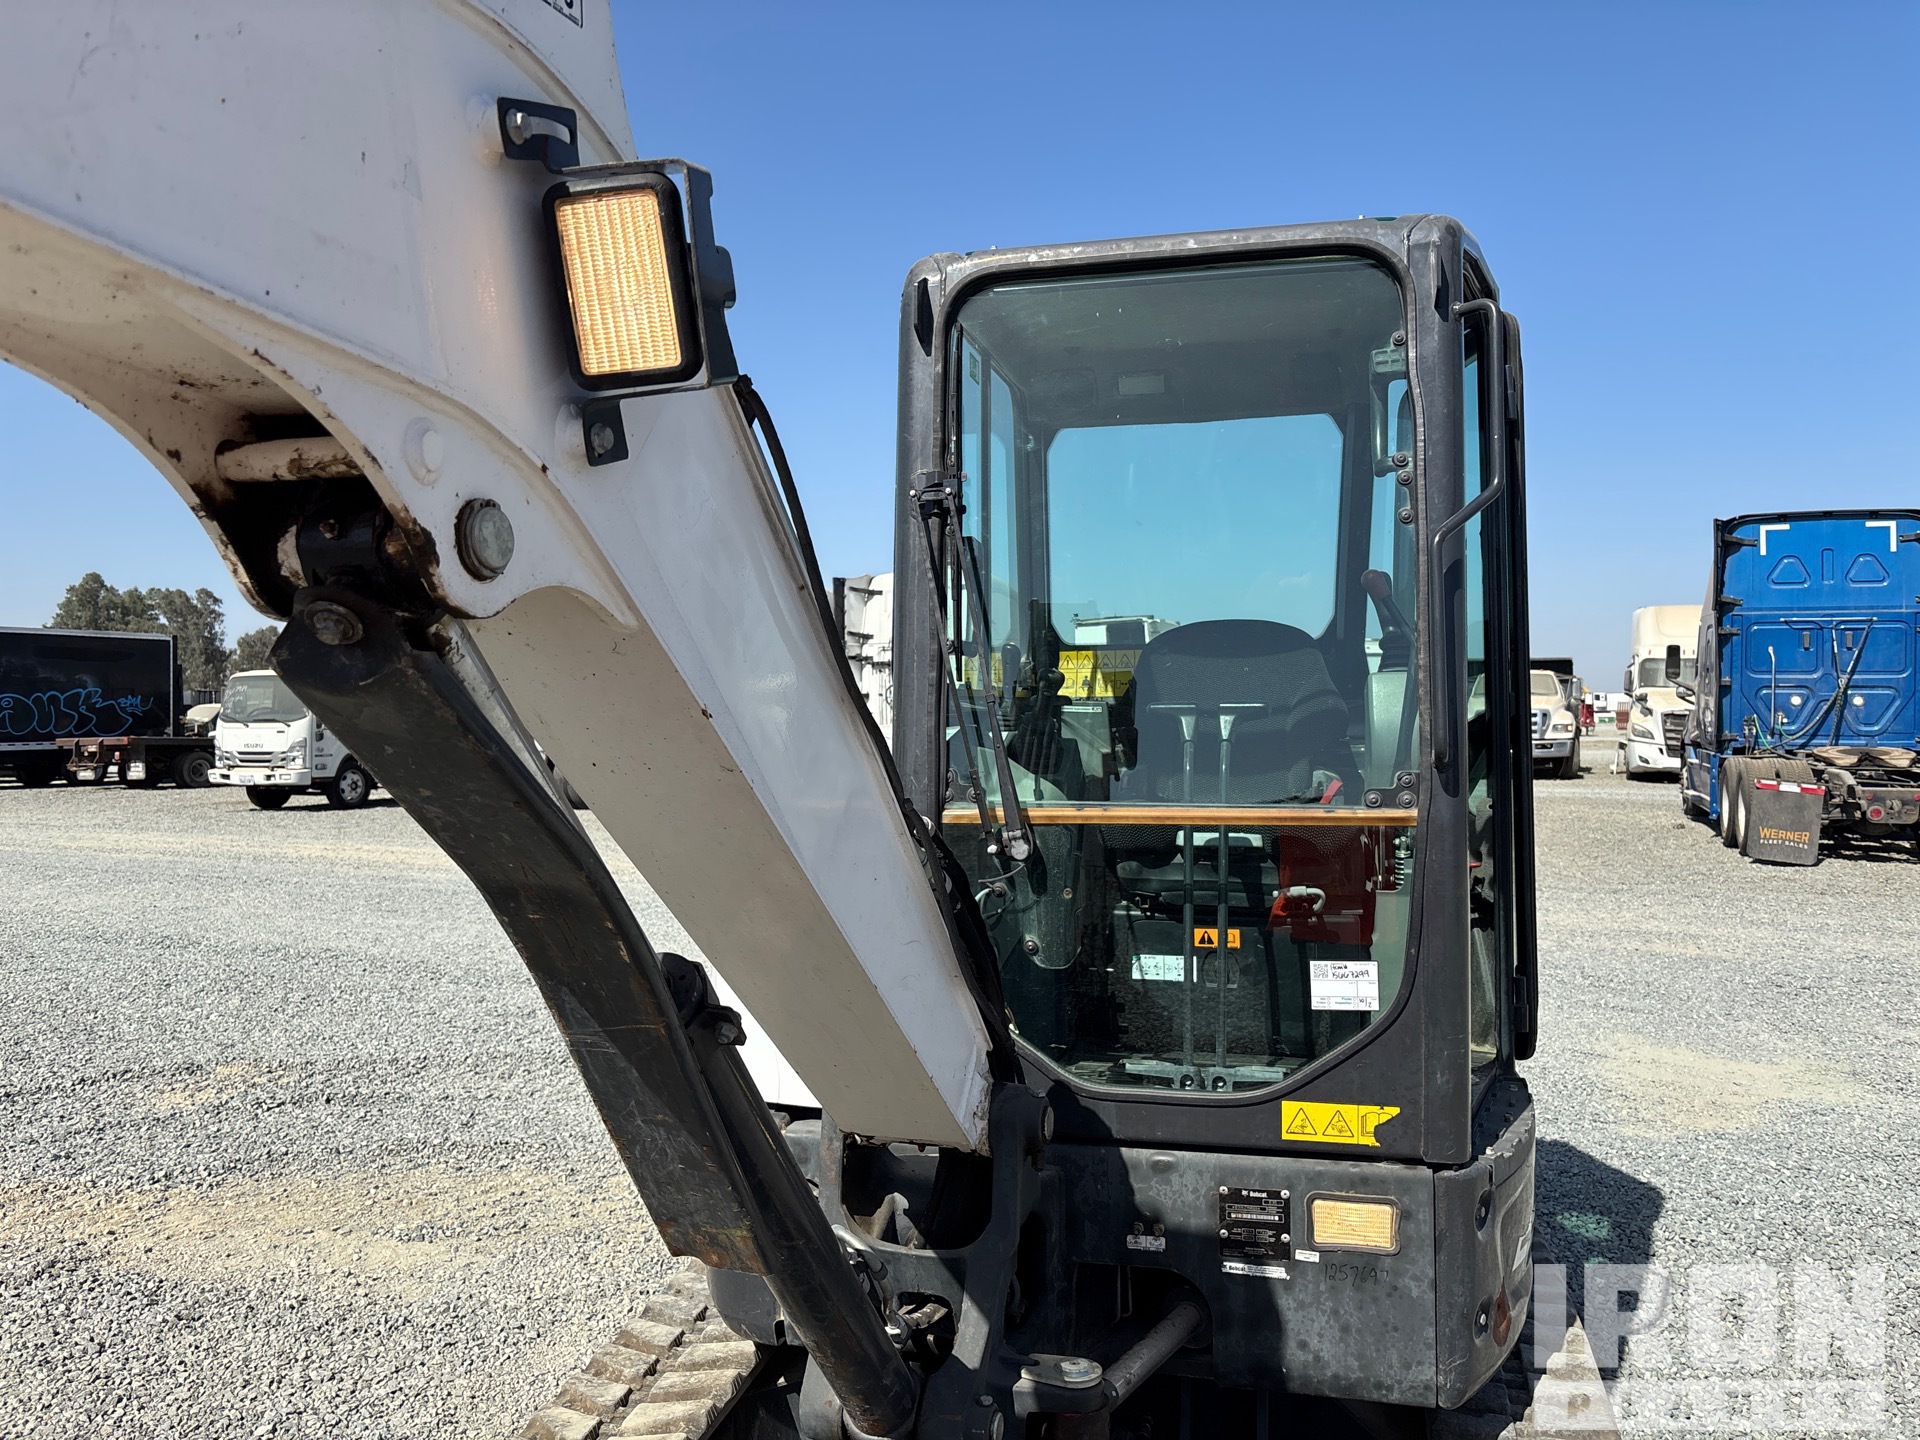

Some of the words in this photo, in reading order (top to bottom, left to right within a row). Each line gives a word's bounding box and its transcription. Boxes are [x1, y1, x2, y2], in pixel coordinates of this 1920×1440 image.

[1759, 826, 1810, 843] WERNER
[1785, 841, 1808, 849] SALES
[1249, 1190, 1268, 1198] Bobcat
[1228, 1265, 1246, 1273] Bobcat
